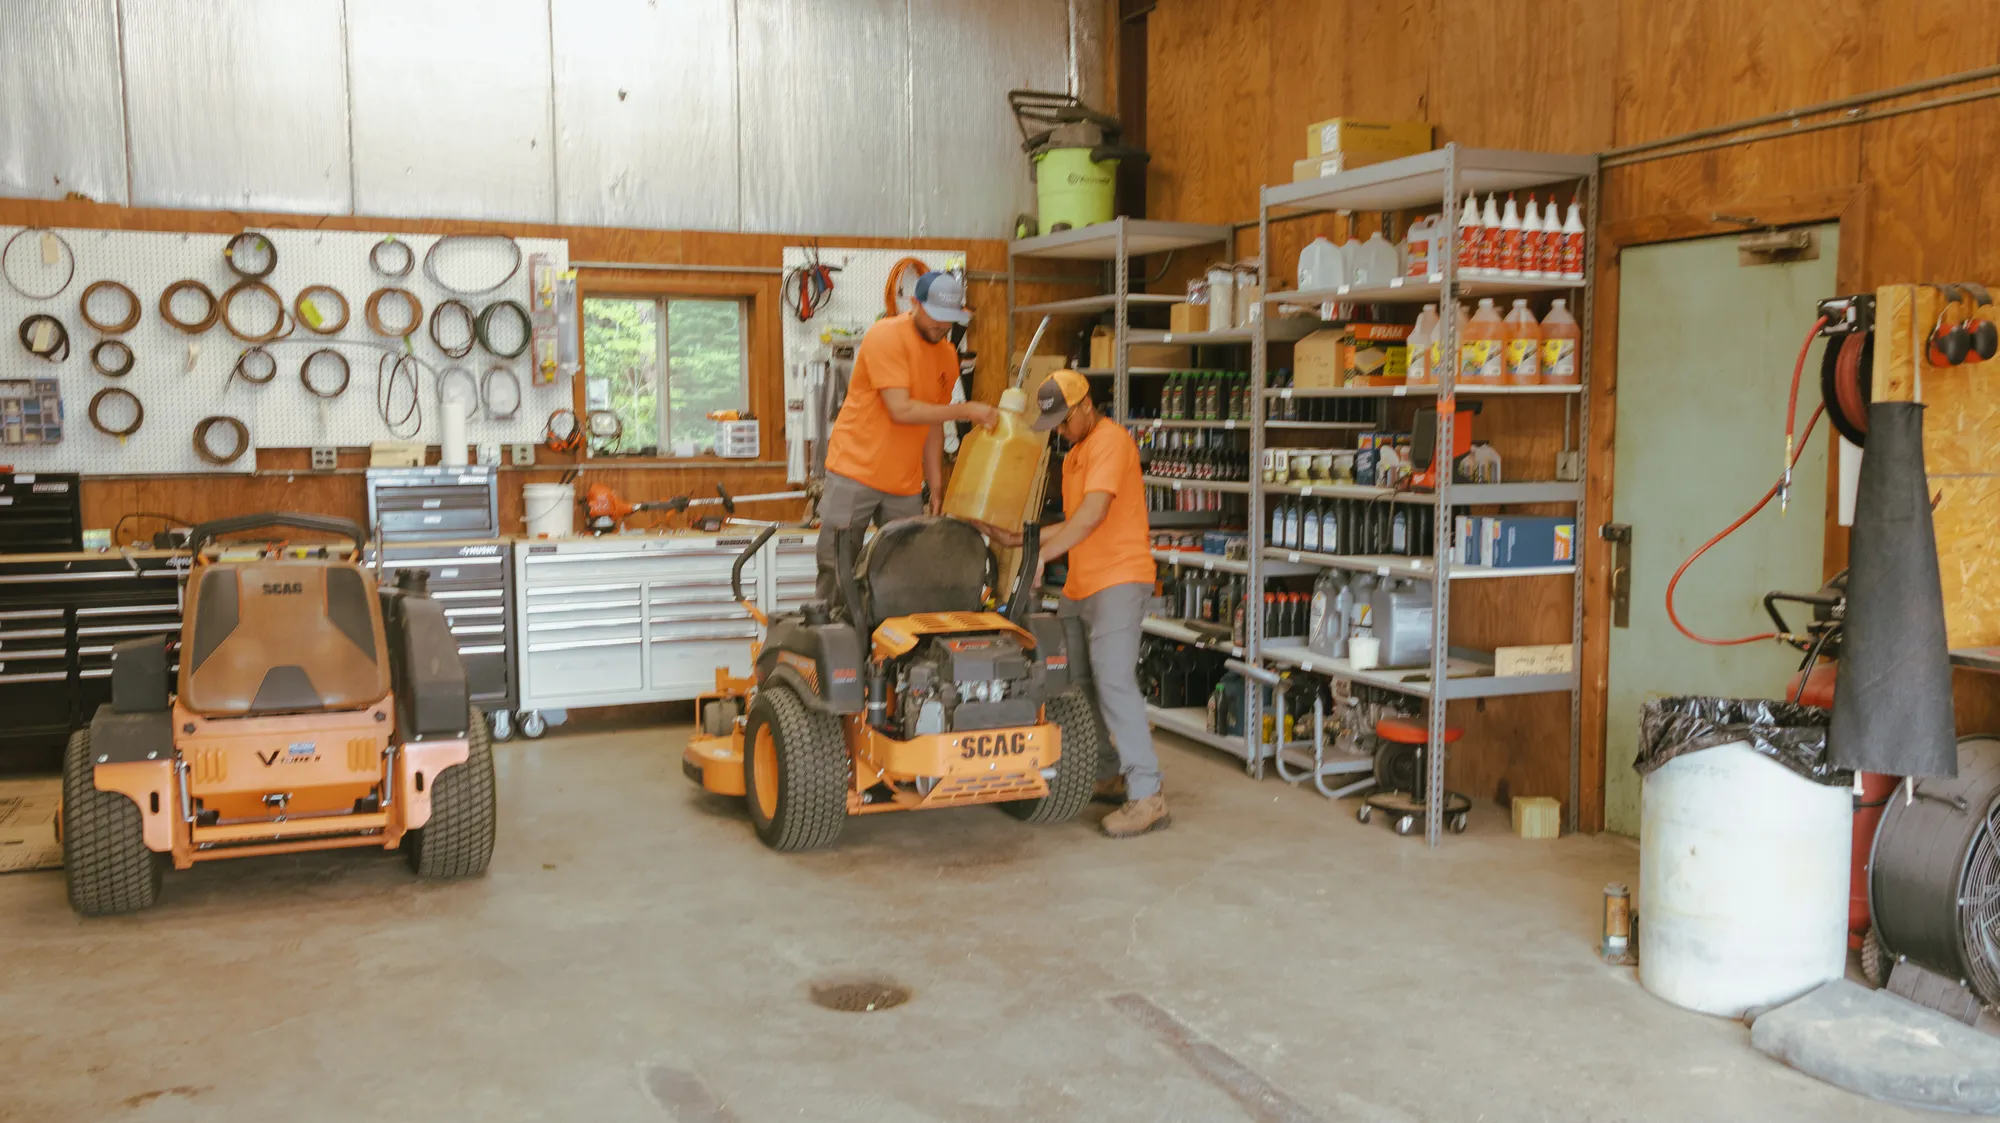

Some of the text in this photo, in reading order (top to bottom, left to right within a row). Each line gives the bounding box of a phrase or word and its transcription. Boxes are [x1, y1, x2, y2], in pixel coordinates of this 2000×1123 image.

[1370, 326, 1403, 338] FRAM
[262, 583, 303, 595] SCAG
[961, 732, 1026, 758] SCAG
